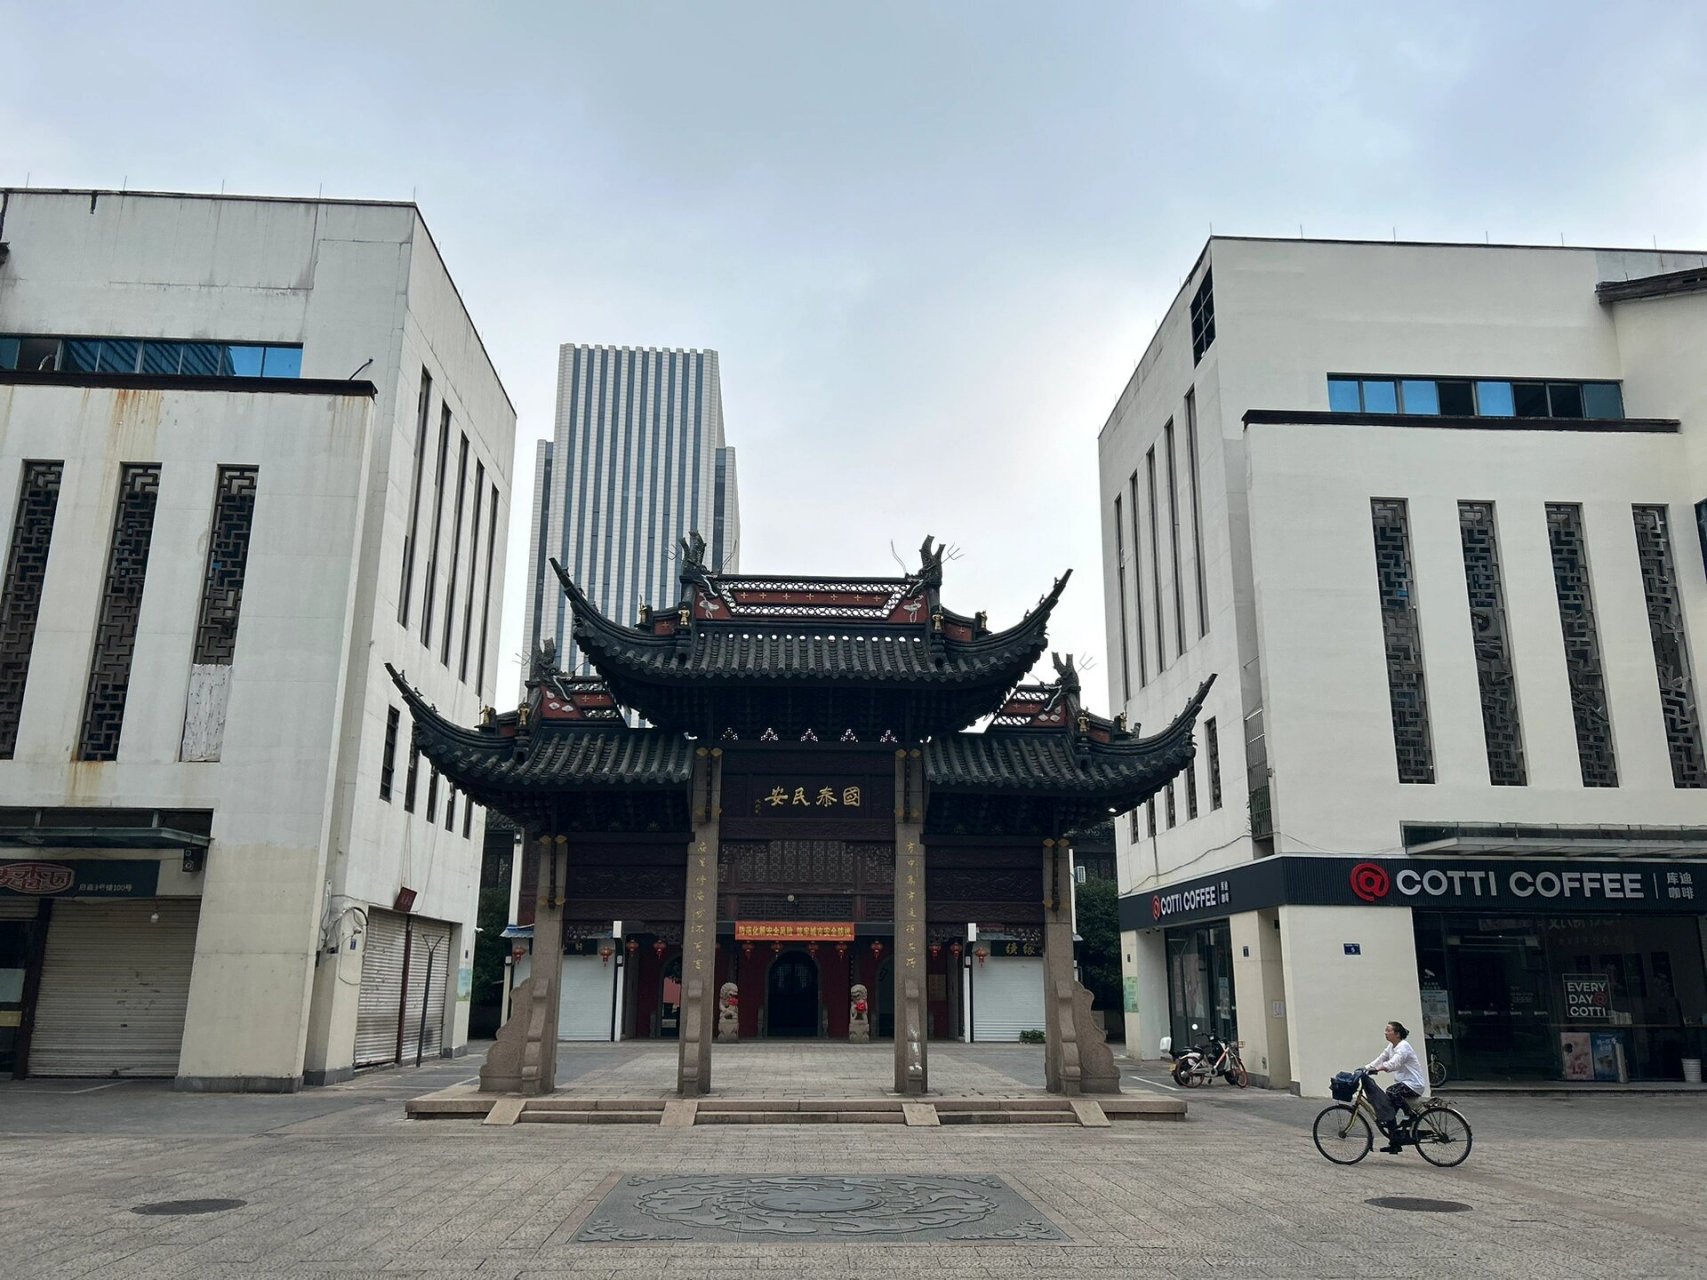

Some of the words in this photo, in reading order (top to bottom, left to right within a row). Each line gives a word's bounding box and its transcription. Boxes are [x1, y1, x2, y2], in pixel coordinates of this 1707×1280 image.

[1396, 869, 1498, 896] COTTI
[1509, 871, 1644, 898] COFFEE
[1667, 872, 1692, 885] 库迪
[1668, 886, 1694, 899] 咖啡
[1161, 893, 1183, 915] COTTI
[1183, 886, 1217, 911] COFFEE
[1567, 982, 1606, 992] EVERY
[1570, 1006, 1606, 1017] COTTI
